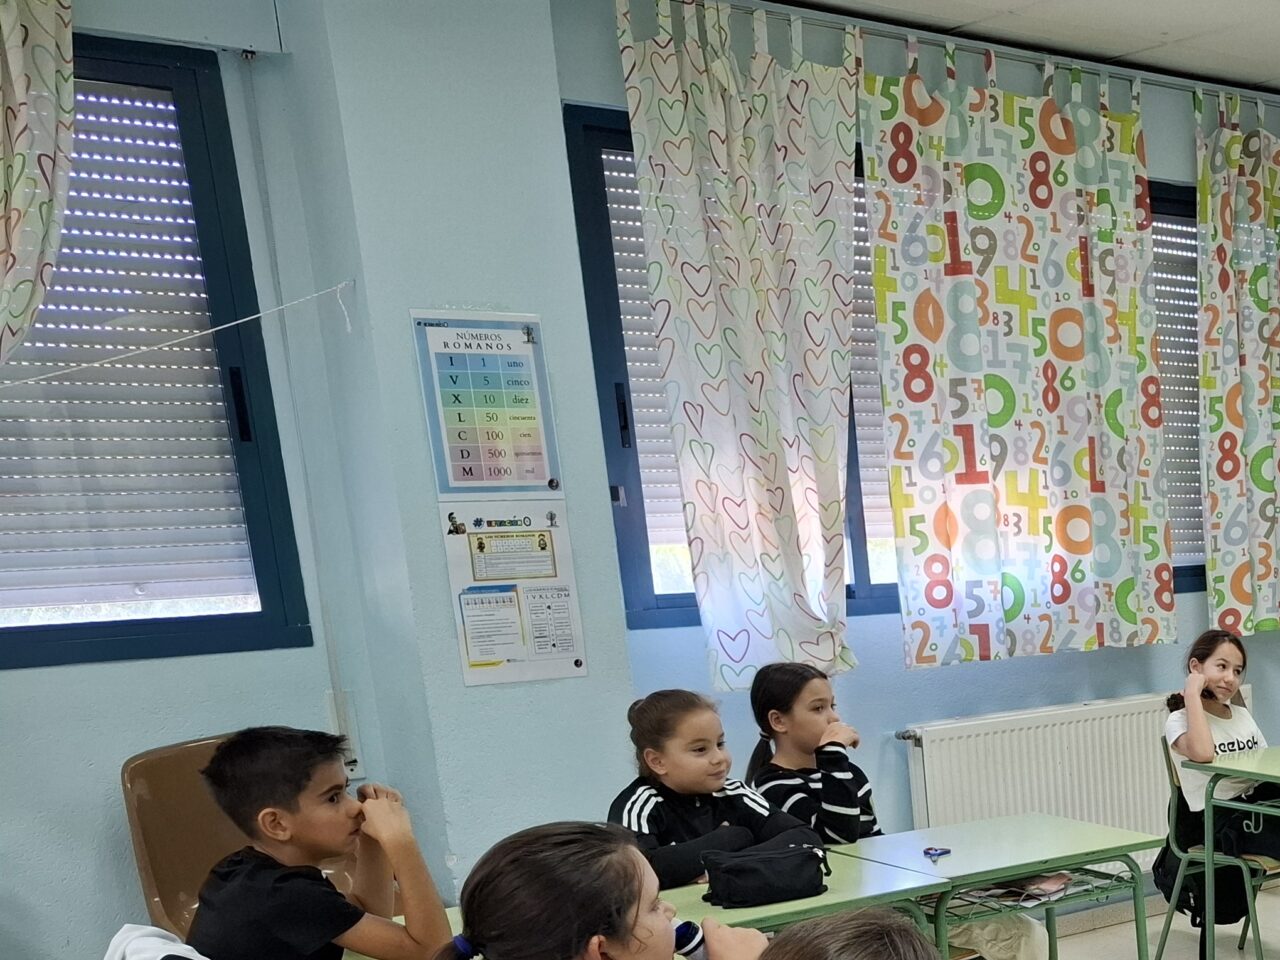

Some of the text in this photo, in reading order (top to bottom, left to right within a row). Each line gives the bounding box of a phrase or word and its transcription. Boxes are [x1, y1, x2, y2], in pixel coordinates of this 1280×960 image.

[456, 330, 502, 341] NÚMEROS
[443, 341, 512, 351] ROMANOS
[449, 356, 524, 368] I 1 uno
[449, 375, 530, 386] V 5 cinco
[451, 394, 529, 404] X 10 diez
[457, 413, 466, 422] L
[485, 413, 498, 422] 50
[458, 431, 467, 441] C
[485, 431, 504, 441] 100
[460, 449, 471, 459] D
[487, 449, 506, 459] 500
[462, 467, 474, 477] M
[487, 467, 512, 477] 1000
